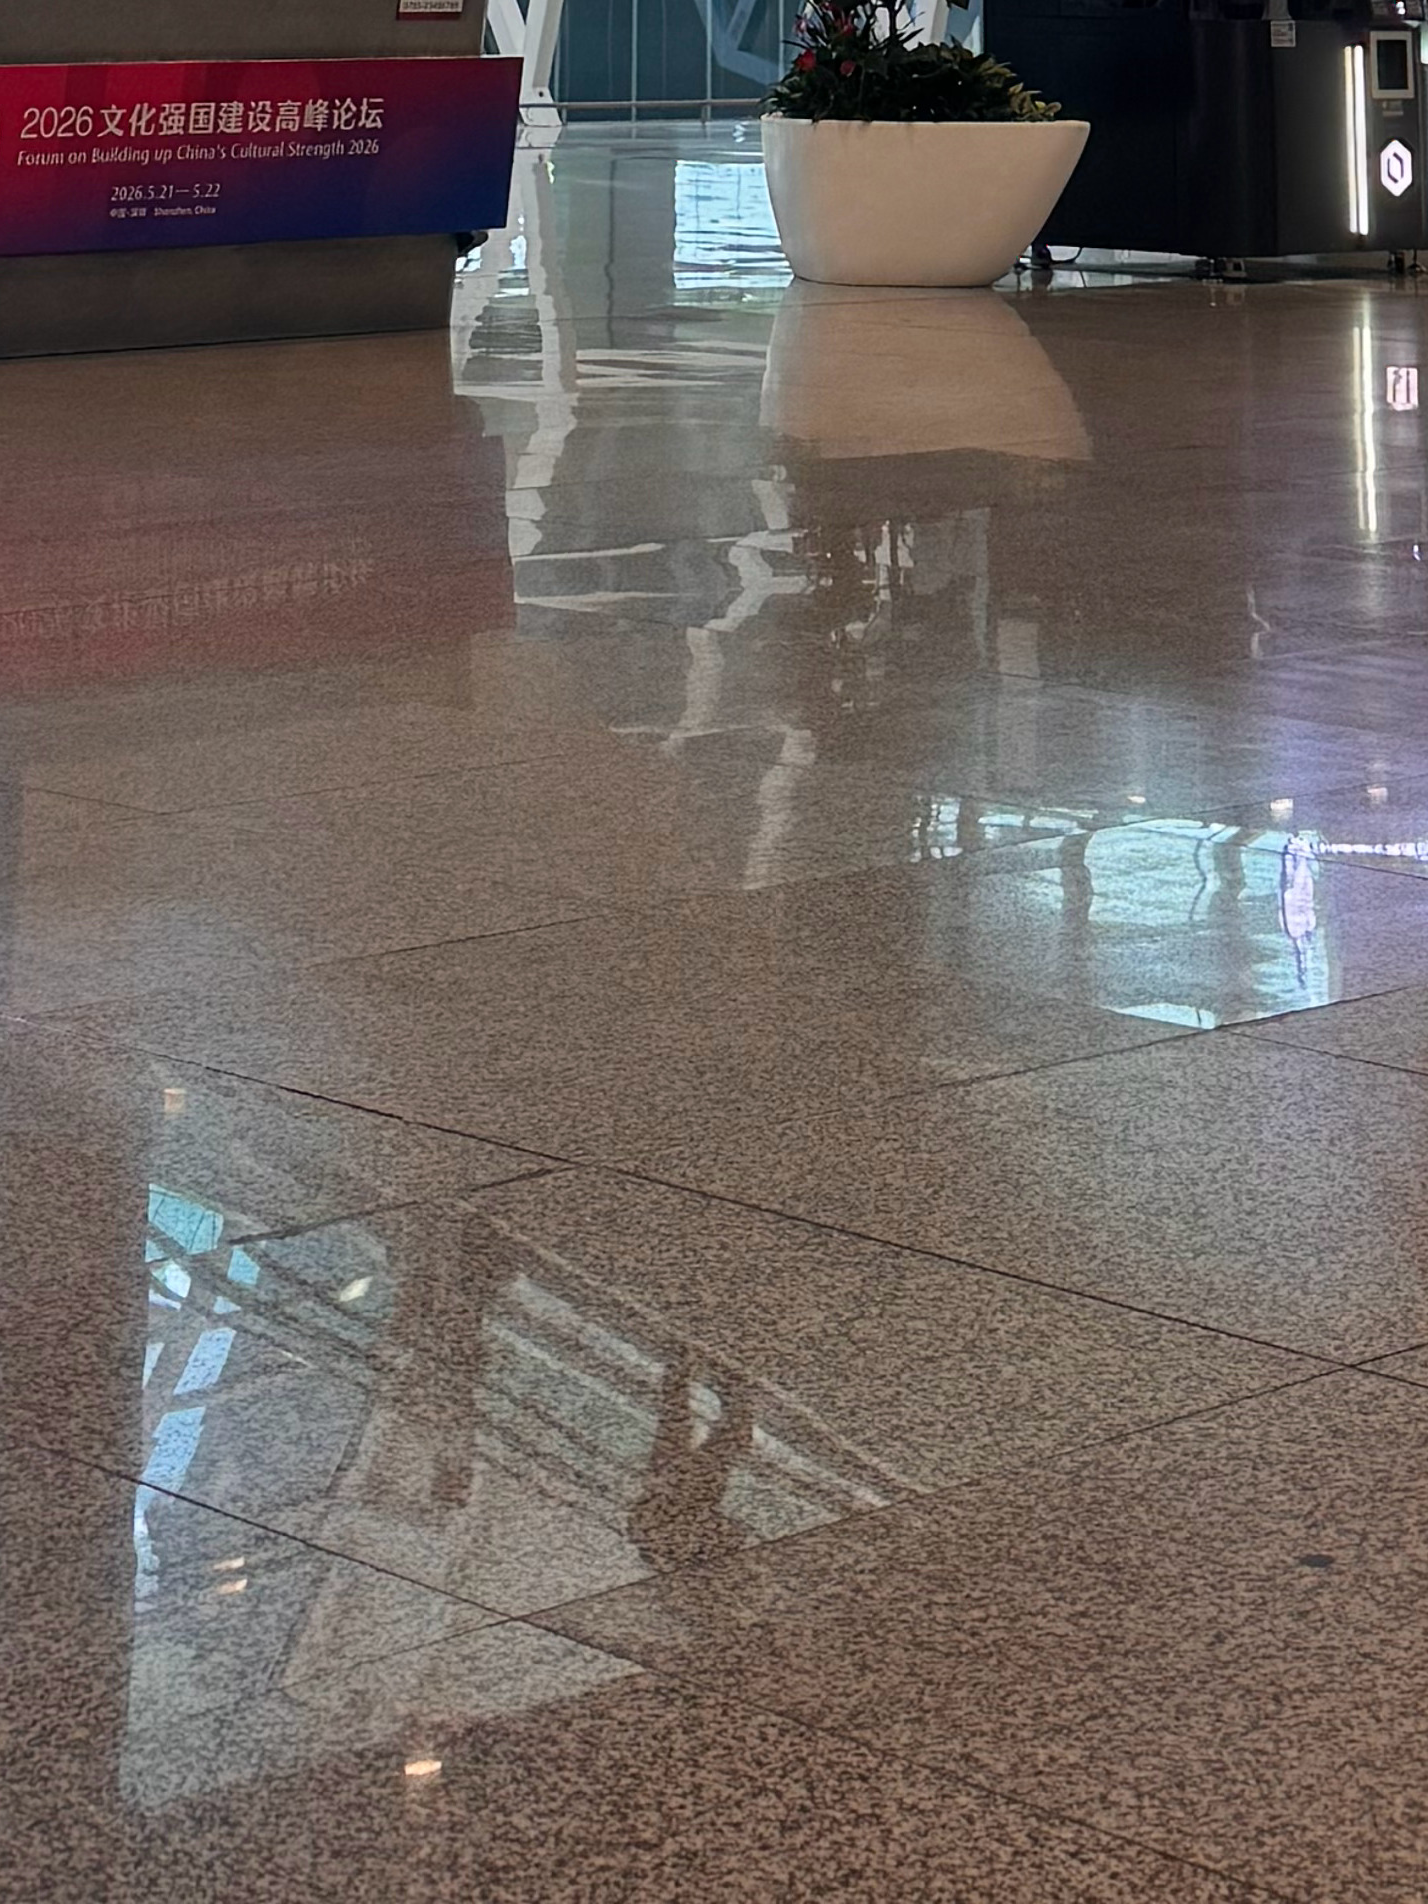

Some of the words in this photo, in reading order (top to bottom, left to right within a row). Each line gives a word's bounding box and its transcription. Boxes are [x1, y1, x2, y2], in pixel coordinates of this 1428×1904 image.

[20, 105, 95, 139] 2026
[97, 97, 385, 137] 文化强国建设高峰论坛
[16, 149, 64, 166] Forum
[68, 151, 87, 165] on
[91, 146, 150, 166] Building
[154, 147, 173, 164] up
[176, 143, 226, 161] China's
[230, 141, 285, 159] Cultural
[287, 139, 345, 161] Strength
[347, 138, 380, 156] 2026
